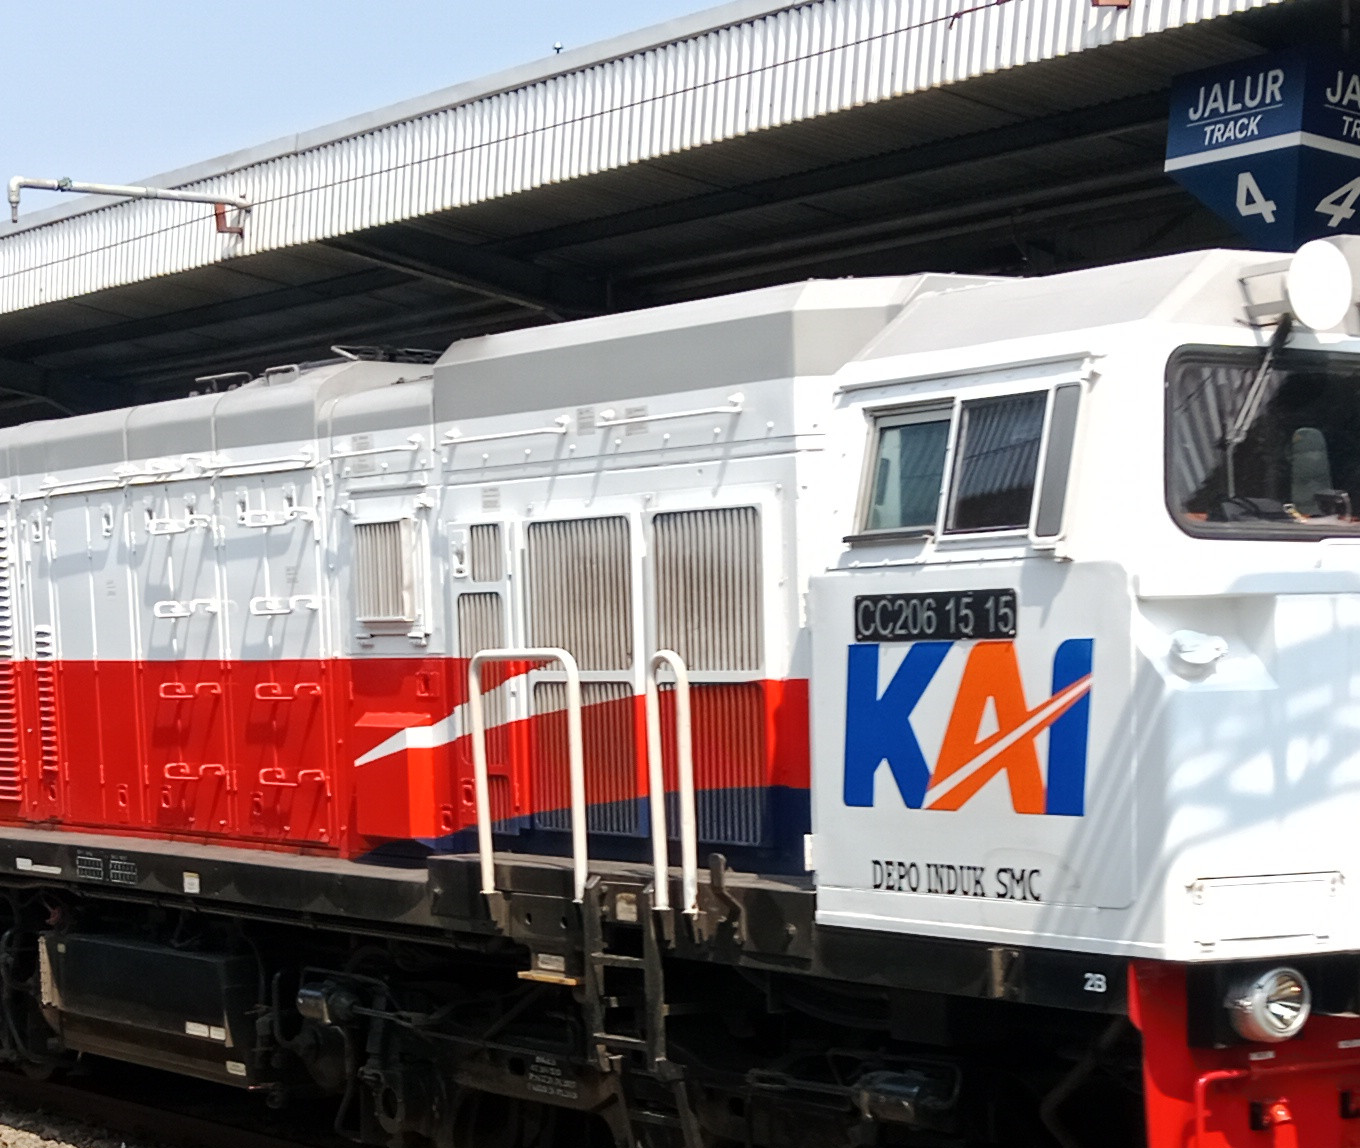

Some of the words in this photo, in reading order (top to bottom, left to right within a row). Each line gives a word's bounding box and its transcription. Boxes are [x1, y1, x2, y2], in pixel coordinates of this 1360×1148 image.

[1187, 69, 1285, 122] JALUR
[1203, 113, 1263, 146] TRACK
[1235, 171, 1277, 224] 4
[857, 598, 937, 636] CC206
[945, 596, 975, 635] 15
[984, 594, 1015, 634] 15
[842, 638, 1096, 816] KAI
[872, 859, 920, 892] DEPO
[926, 863, 986, 897] INDUK
[996, 867, 1042, 902] SMC
[1083, 972, 1108, 993] 2B
